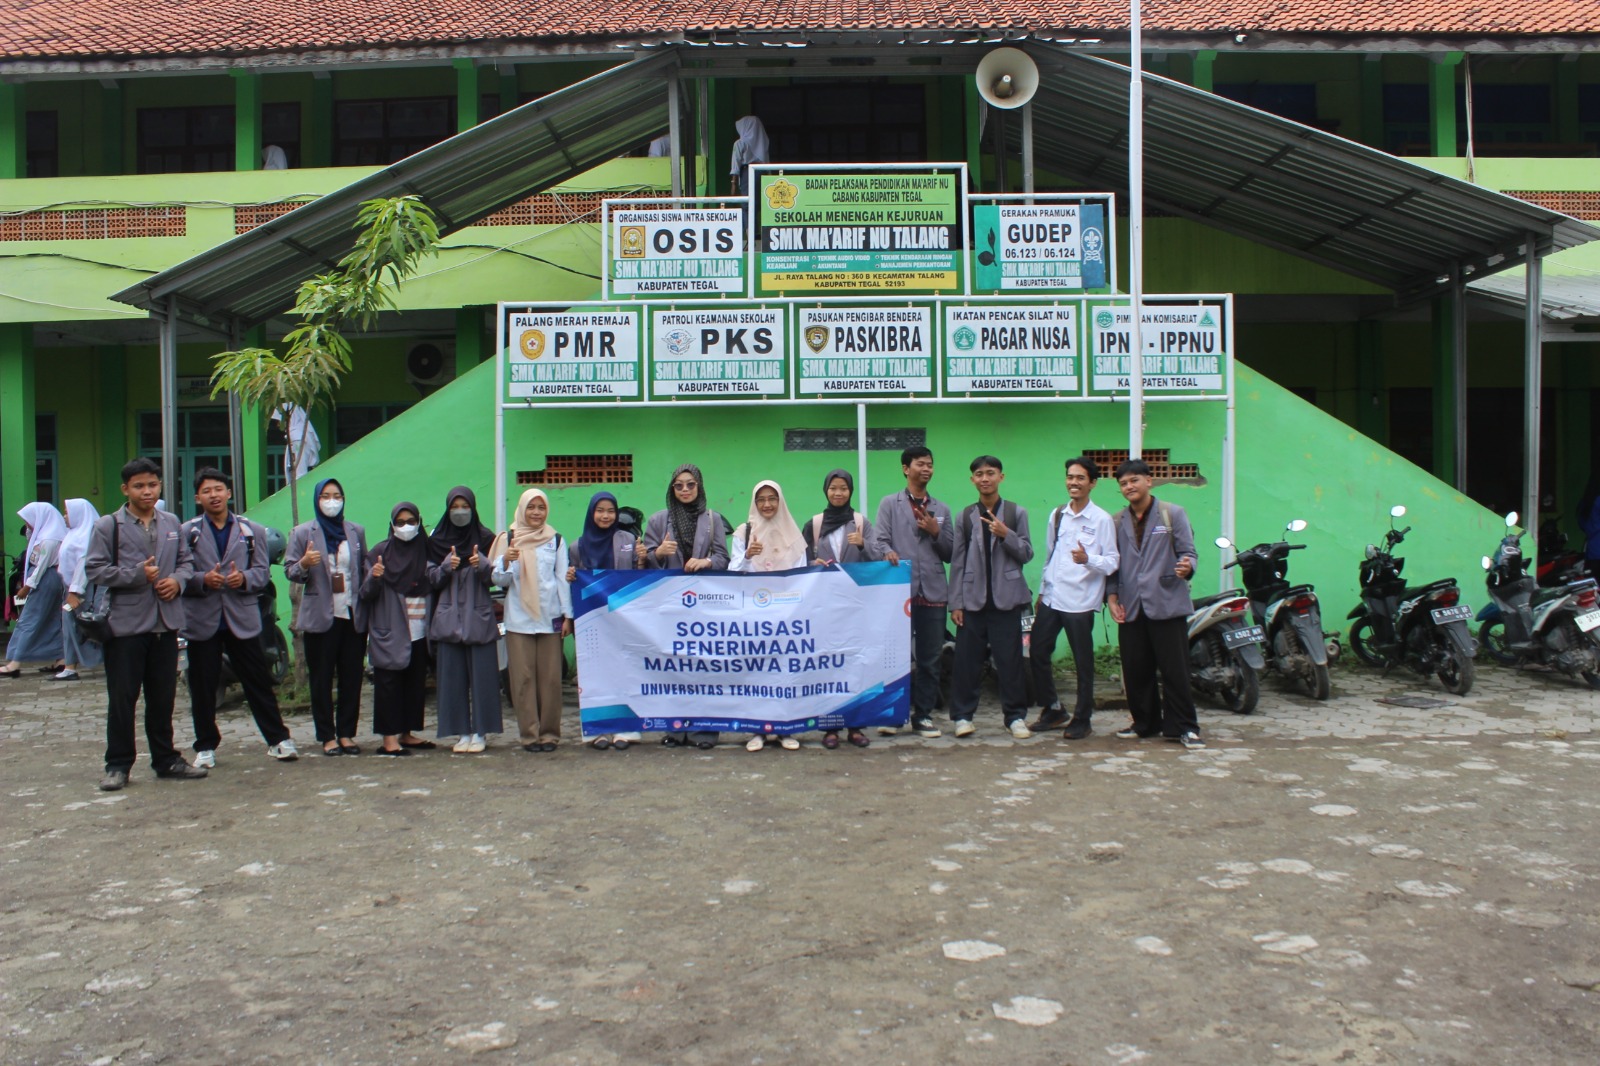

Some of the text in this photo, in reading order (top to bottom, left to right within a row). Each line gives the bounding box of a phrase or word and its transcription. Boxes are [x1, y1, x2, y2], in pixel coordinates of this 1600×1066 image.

[806, 178, 948, 190] BADAN PELAKSANA PENDIDIKAN MA'ARIF NU
[832, 192, 922, 202] CABANG KABUPATEN TEGAL
[619, 212, 737, 222] ORGANISASI SISWA INTRA SEKOLAH
[774, 210, 942, 222] SEKOLAH MENENGAH KEJURUAN
[653, 228, 734, 254] OSIS
[770, 226, 949, 250] SMK MA'ARIF NU TALANG
[1008, 224, 1072, 243] GUDEP
[1006, 249, 1036, 258] 06.123
[1044, 248, 1076, 258] 06.124
[616, 260, 739, 278] SMK MA'ARIF NU TALANG
[1002, 262, 1080, 276] SMK MA'ARIF NU TALANG
[638, 281, 718, 291] KABUPATEN TEGAL
[516, 316, 630, 326] PALANG MERAH REMAJA
[662, 314, 775, 325] PATROLI KEAMANAN SEKOLAH
[808, 312, 922, 322] PASUKAN PENGIBAR BENDERA
[953, 311, 1069, 320] IKATAN PENCAK SILAT NU
[1116, 314, 1197, 323] PIMAN KOMISARIAT
[555, 331, 616, 357] PMR
[701, 328, 773, 354] PKS
[835, 326, 922, 352] PASKIBRA
[982, 327, 1070, 350] PAGAR NUSA
[1100, 332, 1143, 353] IPN
[1161, 332, 1214, 353] IPPNU
[512, 363, 634, 381] SMK MA'ARIF NU TALANG
[656, 361, 780, 380] SMK MA'ARIF NU TALANG
[803, 359, 927, 377] SMK MA'ARIF NU TALANG
[950, 358, 1073, 375] SMK MA'ARIF NU TALANG
[1096, 357, 1120, 374] SMK
[1164, 357, 1178, 374] NU
[1180, 356, 1218, 373] TALANG
[533, 384, 613, 394] KABUPATEN TEGAL
[678, 382, 759, 392] KABUPATEN TEGAL
[824, 380, 906, 390] KABUPATEN TEGAL
[972, 379, 1053, 388] KABUPATEN TEGAL
[1118, 378, 1198, 387] KAPATEN TEGAL
[676, 620, 810, 637] SOSIALISASI
[672, 638, 815, 656] PENERIMAAN
[644, 654, 845, 673] MAHASISWA BARU
[641, 682, 850, 698] UNIVERSITAS TEKNOLOGI DIGITAL
